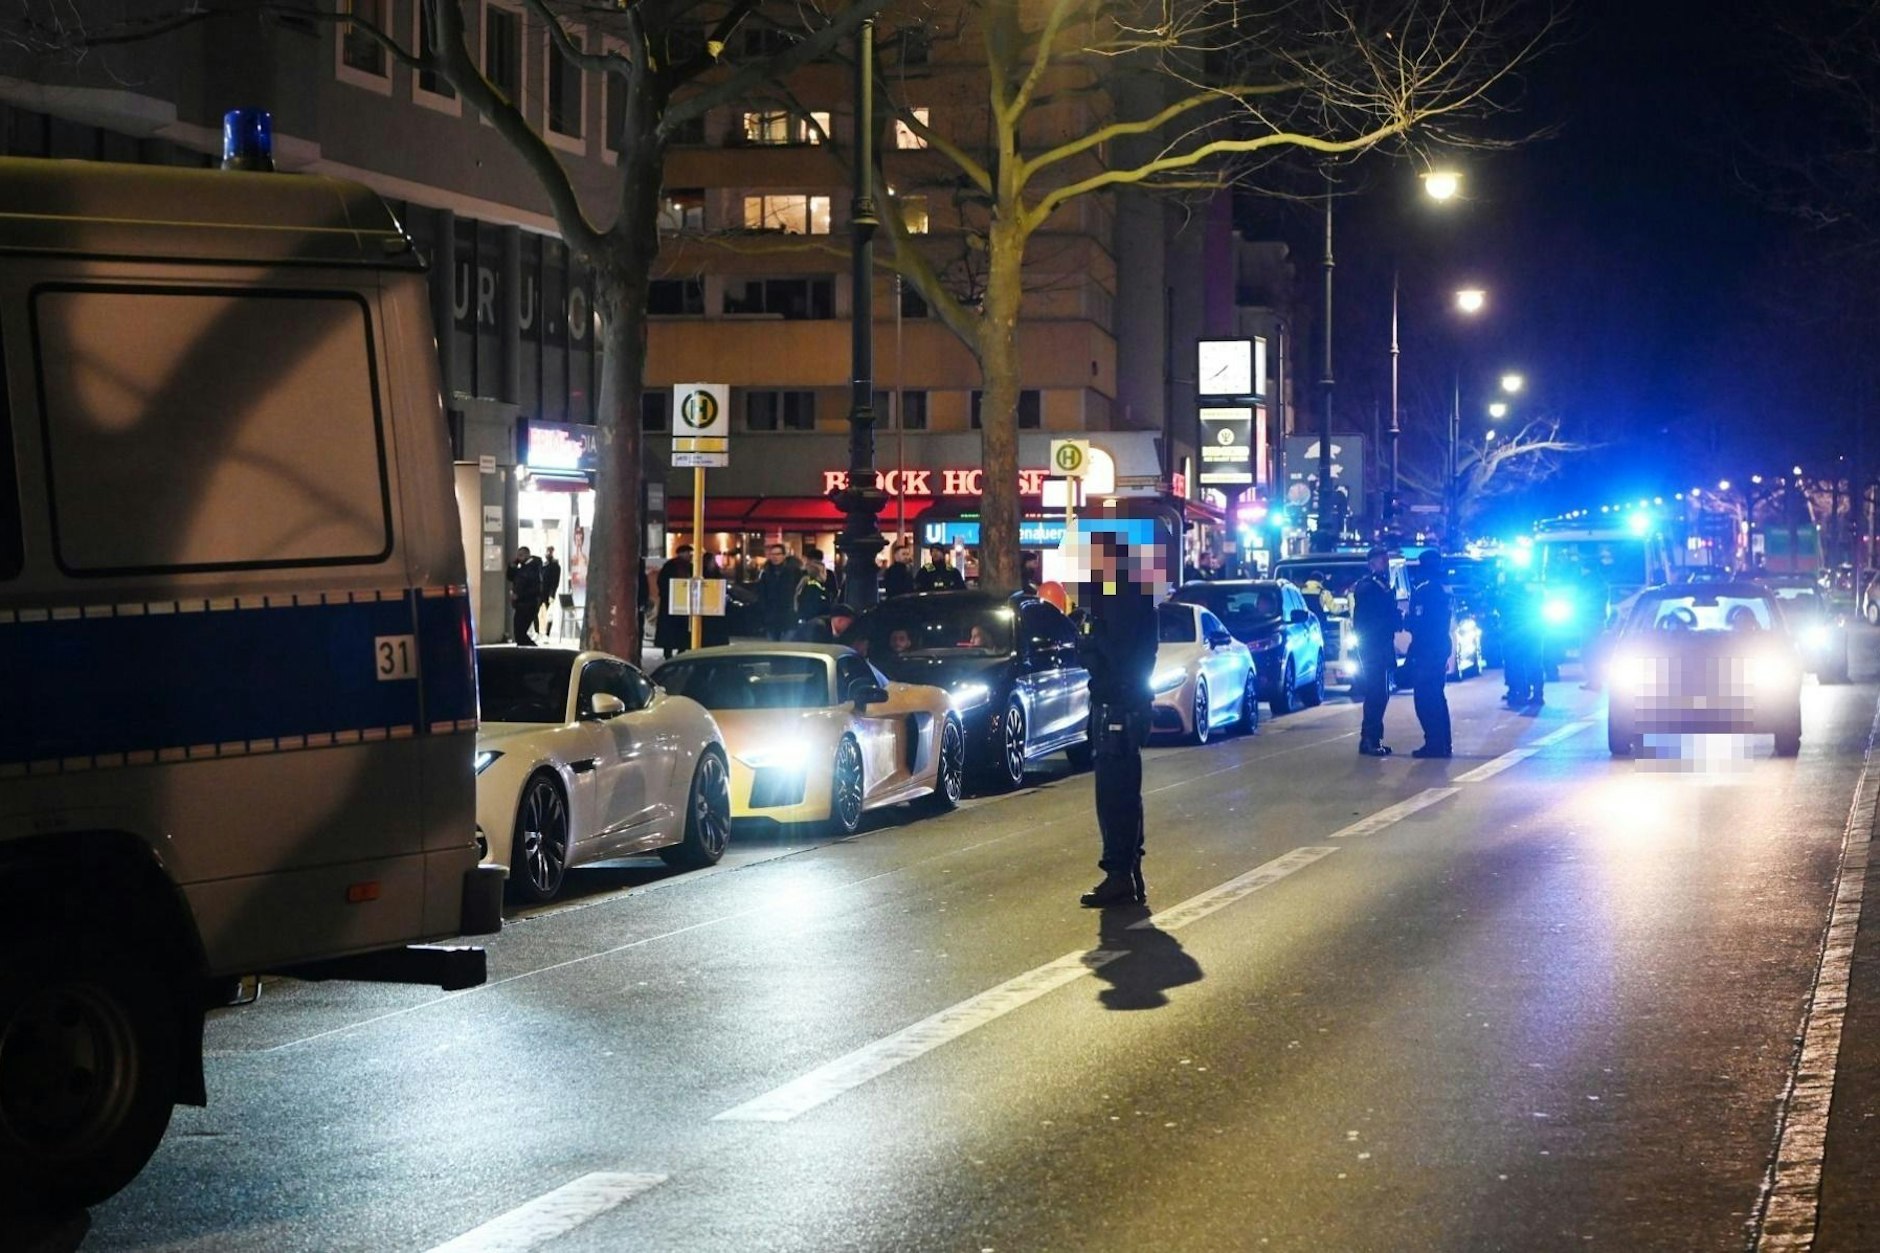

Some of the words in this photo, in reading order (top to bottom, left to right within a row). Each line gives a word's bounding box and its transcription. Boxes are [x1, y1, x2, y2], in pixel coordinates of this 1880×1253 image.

[690, 398, 708, 420] H
[1063, 451, 1075, 465] H
[942, 470, 1050, 495] HOSE
[926, 524, 942, 543] U
[380, 641, 408, 675] 31
